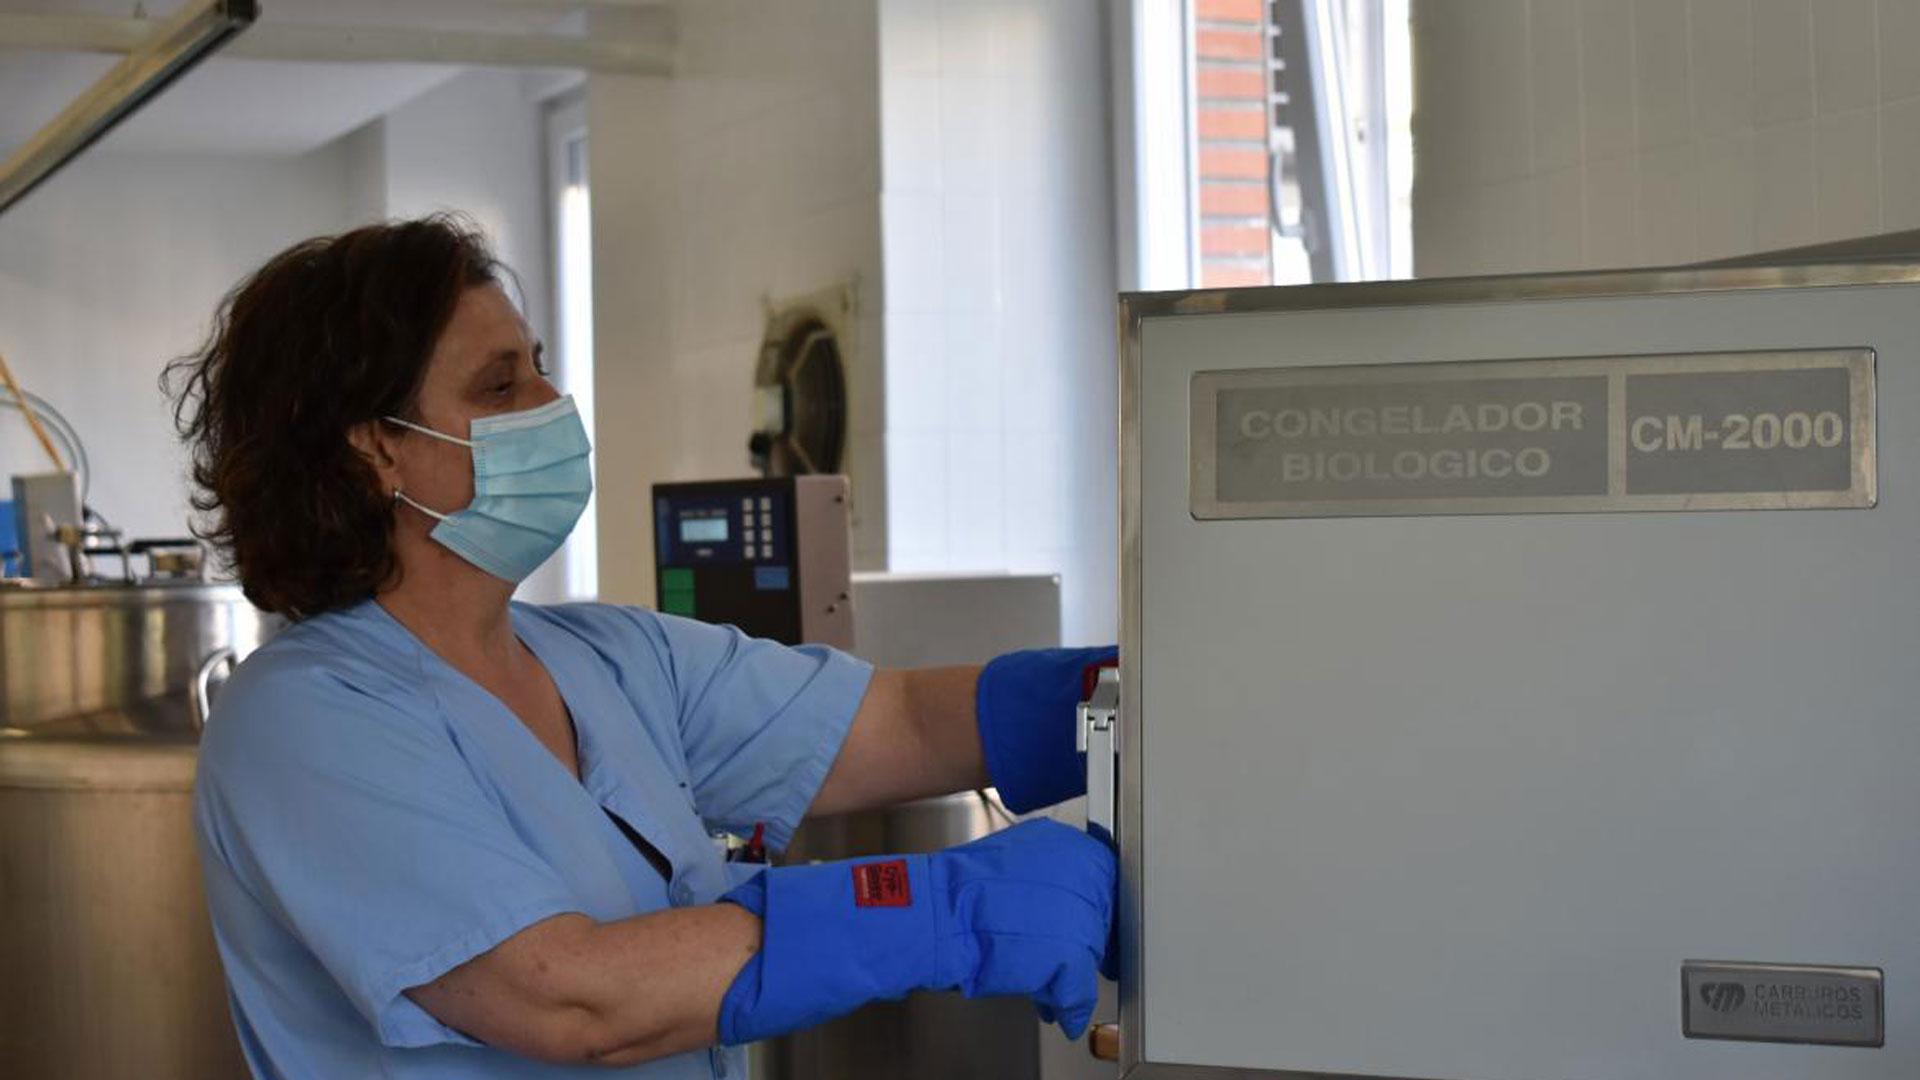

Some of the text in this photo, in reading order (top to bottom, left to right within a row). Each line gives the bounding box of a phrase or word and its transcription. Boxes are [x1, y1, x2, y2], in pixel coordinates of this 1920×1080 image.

[1240, 400, 1584, 438] CONGELADOR
[1631, 411, 1843, 452] CM-2000
[1282, 447, 1550, 482] BIOLOGICO
[1755, 984, 1862, 1001] CARBUROS
